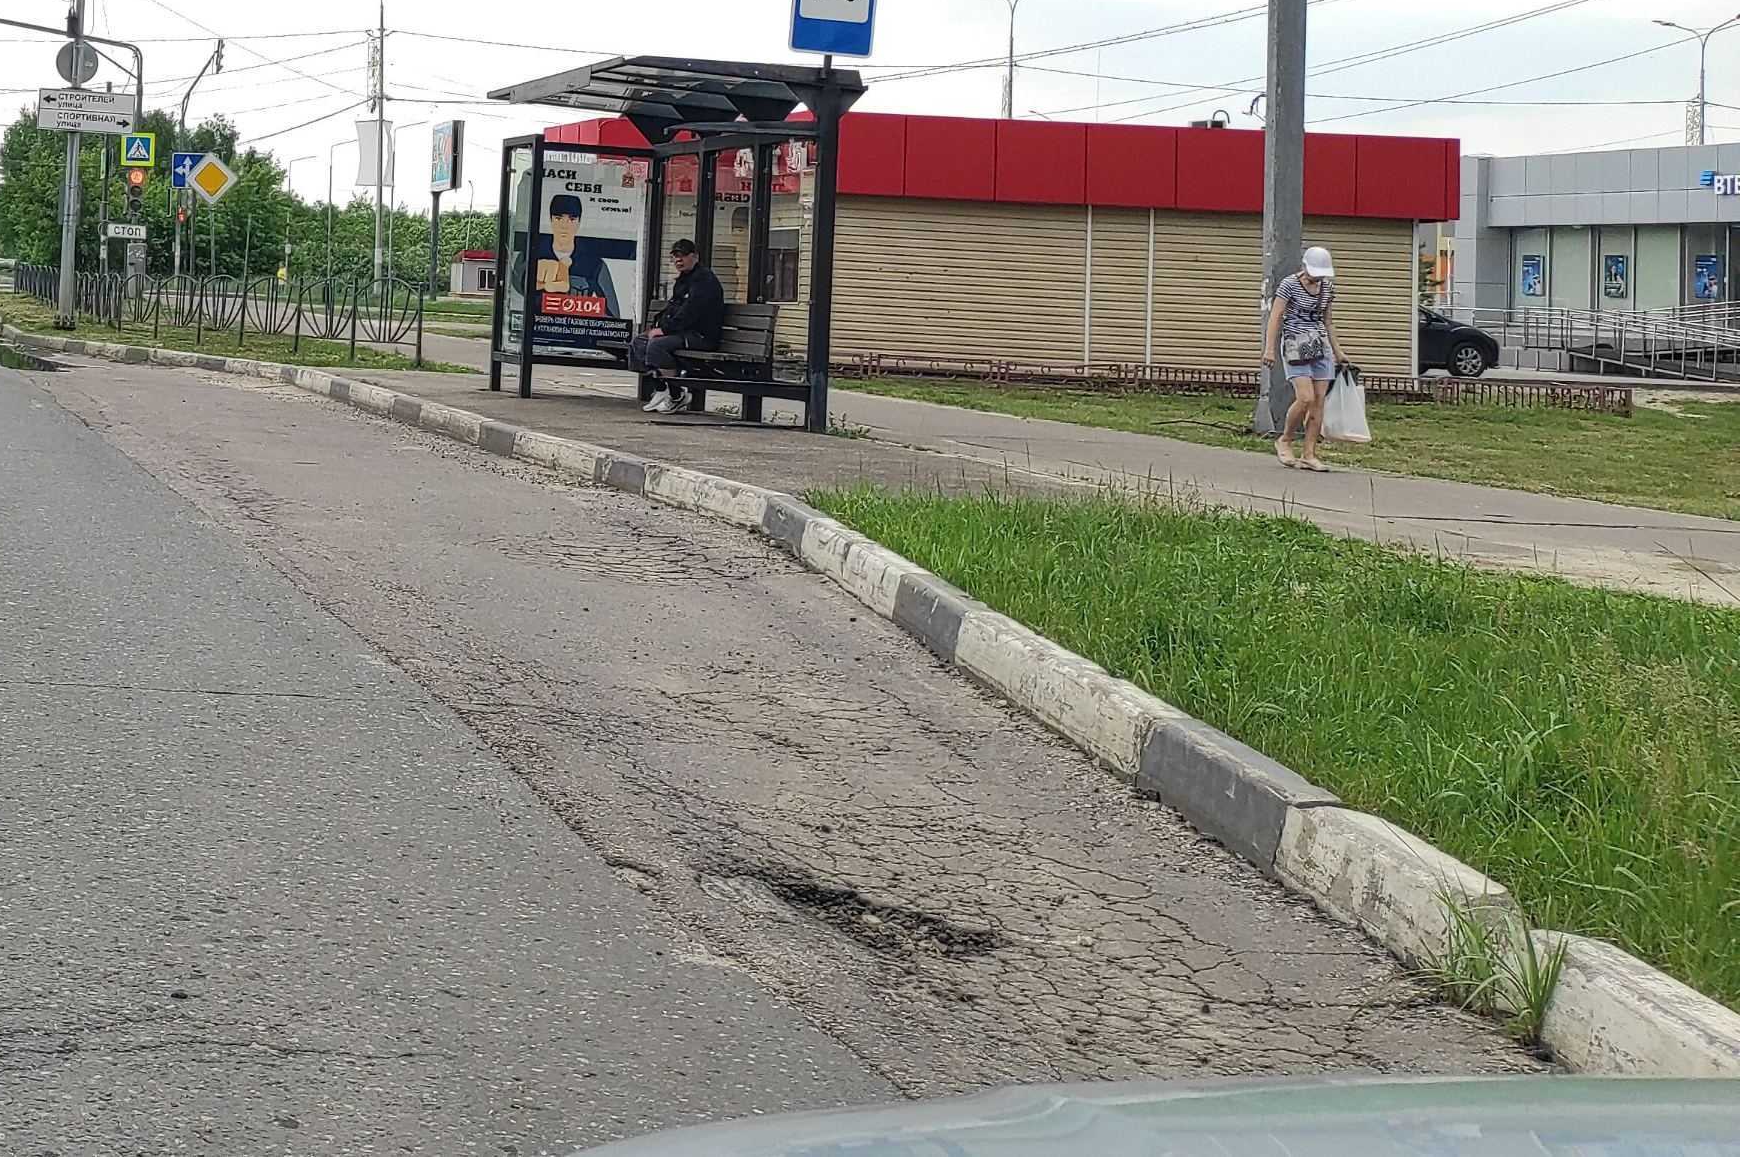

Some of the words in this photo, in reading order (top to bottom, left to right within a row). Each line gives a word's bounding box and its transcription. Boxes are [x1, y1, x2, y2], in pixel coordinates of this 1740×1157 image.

[58, 93, 115, 104] СТРОИТЕЛЕЙ
[57, 112, 116, 123] СПОРТИВНАЯ
[542, 168, 578, 180] АСИ
[565, 182, 603, 194] СЕБЯ
[113, 225, 141, 236] СТОП
[575, 299, 602, 314] 104
